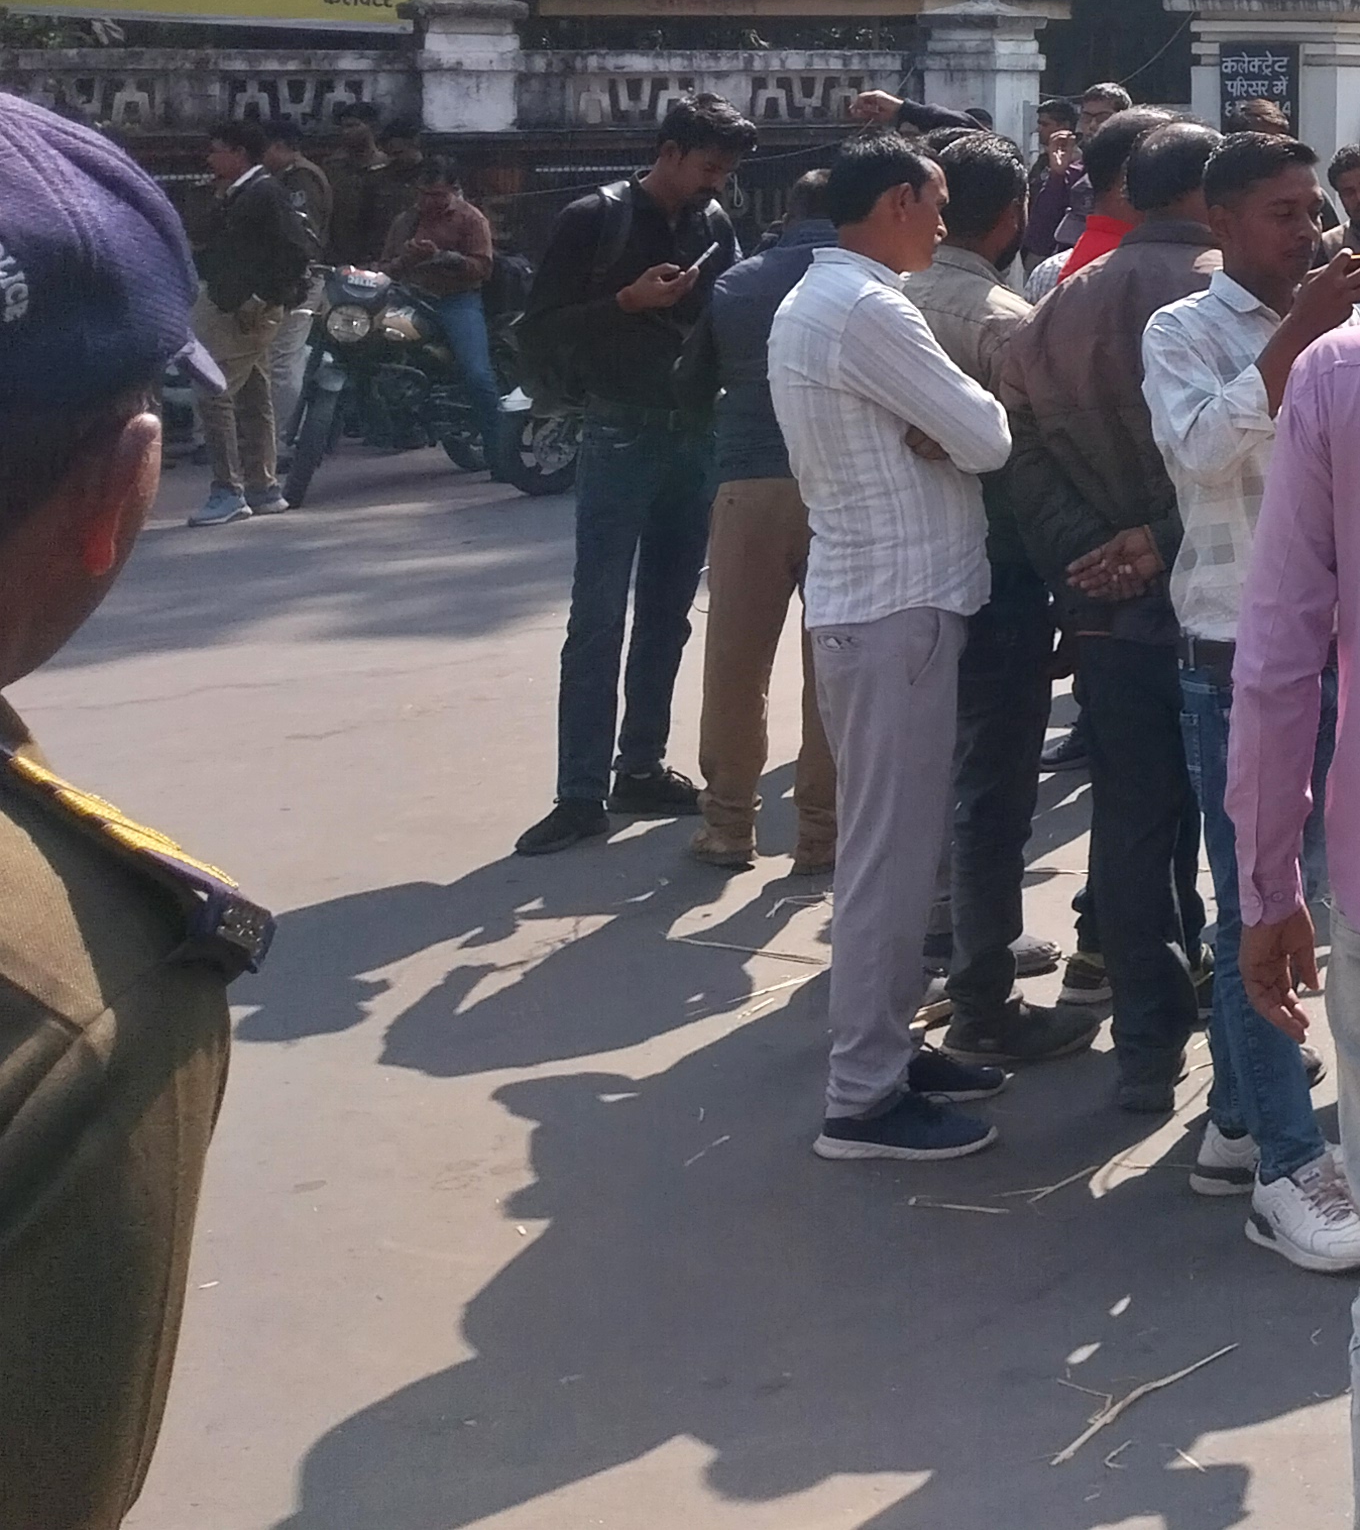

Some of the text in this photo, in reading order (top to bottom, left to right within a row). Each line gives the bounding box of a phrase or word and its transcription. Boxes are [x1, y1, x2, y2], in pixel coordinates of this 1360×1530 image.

[1222, 50, 1290, 76] कलेक्ट्रेट
[1225, 75, 1289, 97] परिसर में
